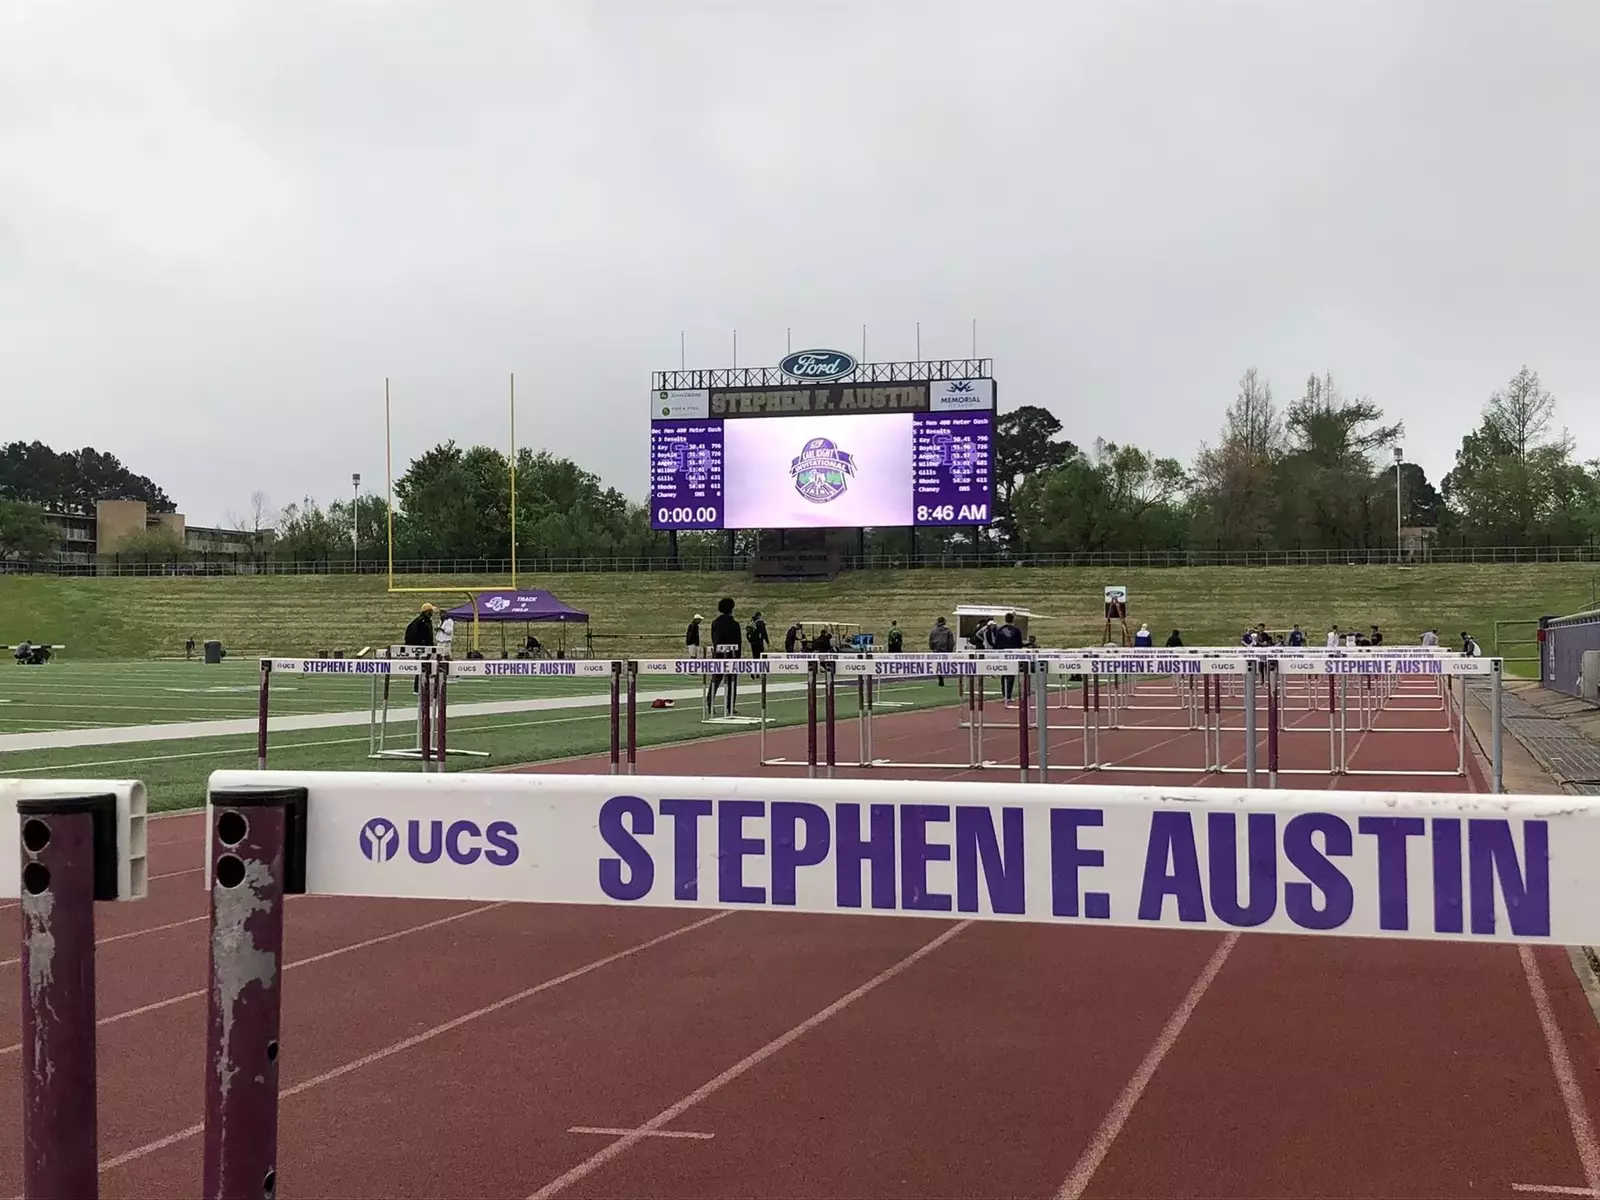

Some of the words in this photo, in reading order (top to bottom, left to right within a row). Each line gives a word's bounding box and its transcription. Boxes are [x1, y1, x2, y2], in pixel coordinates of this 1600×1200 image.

[793, 354, 841, 375] Ford
[712, 389, 811, 414] STEPHEN
[815, 389, 835, 411] F.
[839, 386, 926, 410] AUSTIN
[940, 396, 981, 404] MEMORIAL
[795, 459, 847, 472] INVITATIONAL
[658, 507, 717, 523] 0:00.00
[917, 504, 955, 521] 8:46
[957, 504, 988, 520] AM
[303, 661, 348, 673] STEPHEN
[349, 661, 354, 673] F.
[355, 661, 391, 674] AUSTIN
[484, 662, 530, 675] STEPHEN
[531, 662, 537, 675] F.
[539, 662, 576, 675] AUSTIN
[675, 661, 722, 673] STEPHEN
[723, 661, 729, 674] F.
[731, 661, 770, 673] AUSTIN
[875, 661, 925, 674] STEPHEN
[926, 661, 933, 674] F.
[936, 661, 977, 674] AUSTIN
[1066, 662, 1082, 670] UCS
[1091, 660, 1144, 673] STEPHEN
[1146, 660, 1154, 673] F.
[1156, 660, 1201, 673] AUSTIN
[1297, 662, 1315, 670] UCS
[1324, 659, 1382, 674] STEPHEN
[1384, 659, 1392, 674] F.
[1394, 659, 1442, 674] AUSTIN
[407, 819, 520, 866] UCS
[599, 795, 1026, 915] STEPHEN
[1050, 807, 1111, 919] F.
[1137, 810, 1551, 938] AUSTIN
